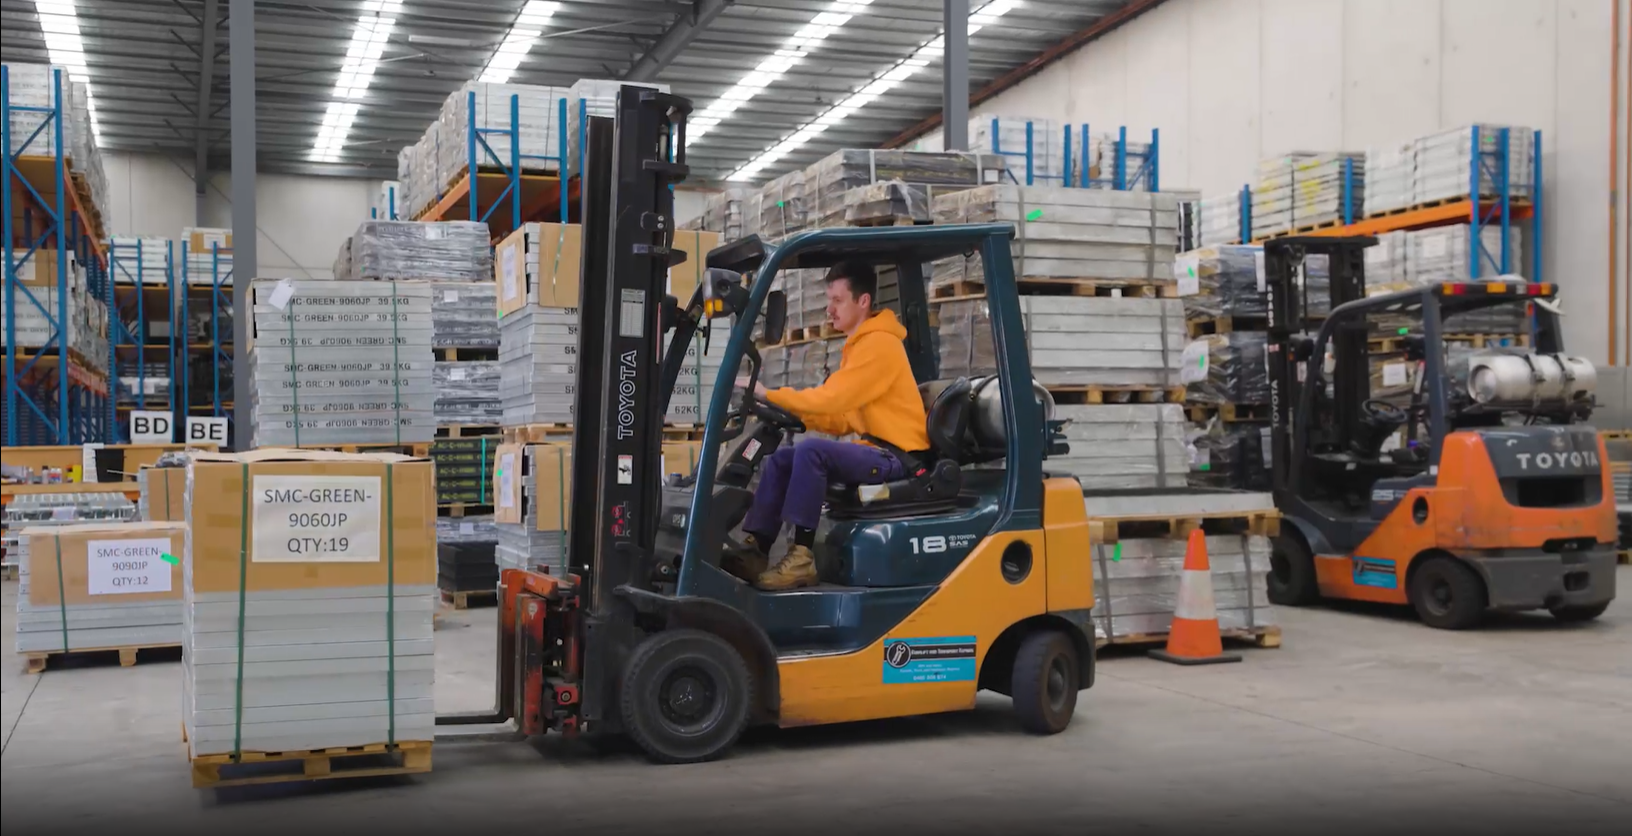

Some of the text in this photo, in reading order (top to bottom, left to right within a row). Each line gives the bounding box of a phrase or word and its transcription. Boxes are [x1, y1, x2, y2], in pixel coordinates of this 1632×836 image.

[286, 297, 371, 306] MC-GREEN-9060JP
[617, 349, 637, 440] TOYOTA
[1270, 379, 1280, 429] TOYOTA
[134, 417, 169, 435] BD
[191, 422, 223, 440] BE
[1516, 451, 1599, 470] TOYOTA
[264, 489, 372, 503] SMC-GREEN-
[289, 512, 348, 528] 9060JP
[287, 537, 349, 554] QTY:19
[909, 536, 947, 554] 18
[112, 561, 148, 571] 9090JP
[112, 576, 149, 587] QTY:12
